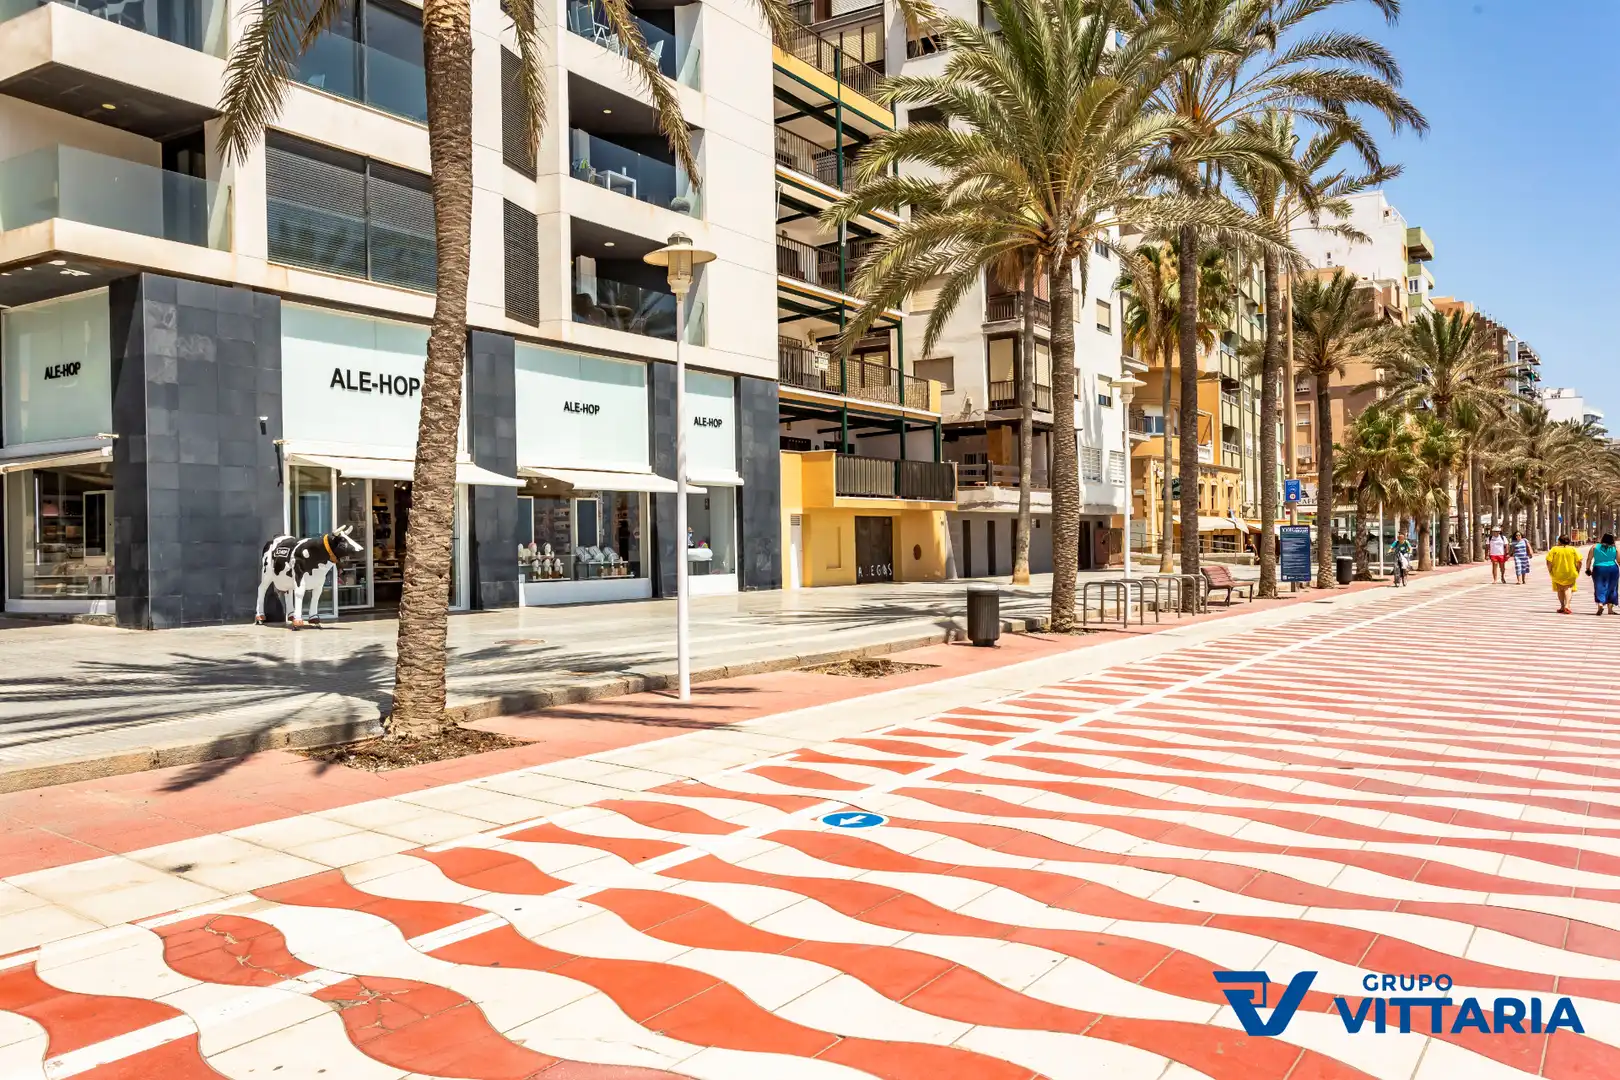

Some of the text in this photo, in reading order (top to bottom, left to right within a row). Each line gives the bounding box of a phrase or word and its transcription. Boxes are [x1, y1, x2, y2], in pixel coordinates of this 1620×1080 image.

[45, 361, 81, 380] ALE-HOP
[330, 367, 421, 397] ALE-HOP
[563, 401, 600, 415] ALE-HOP
[693, 416, 723, 428] ALE-HOP
